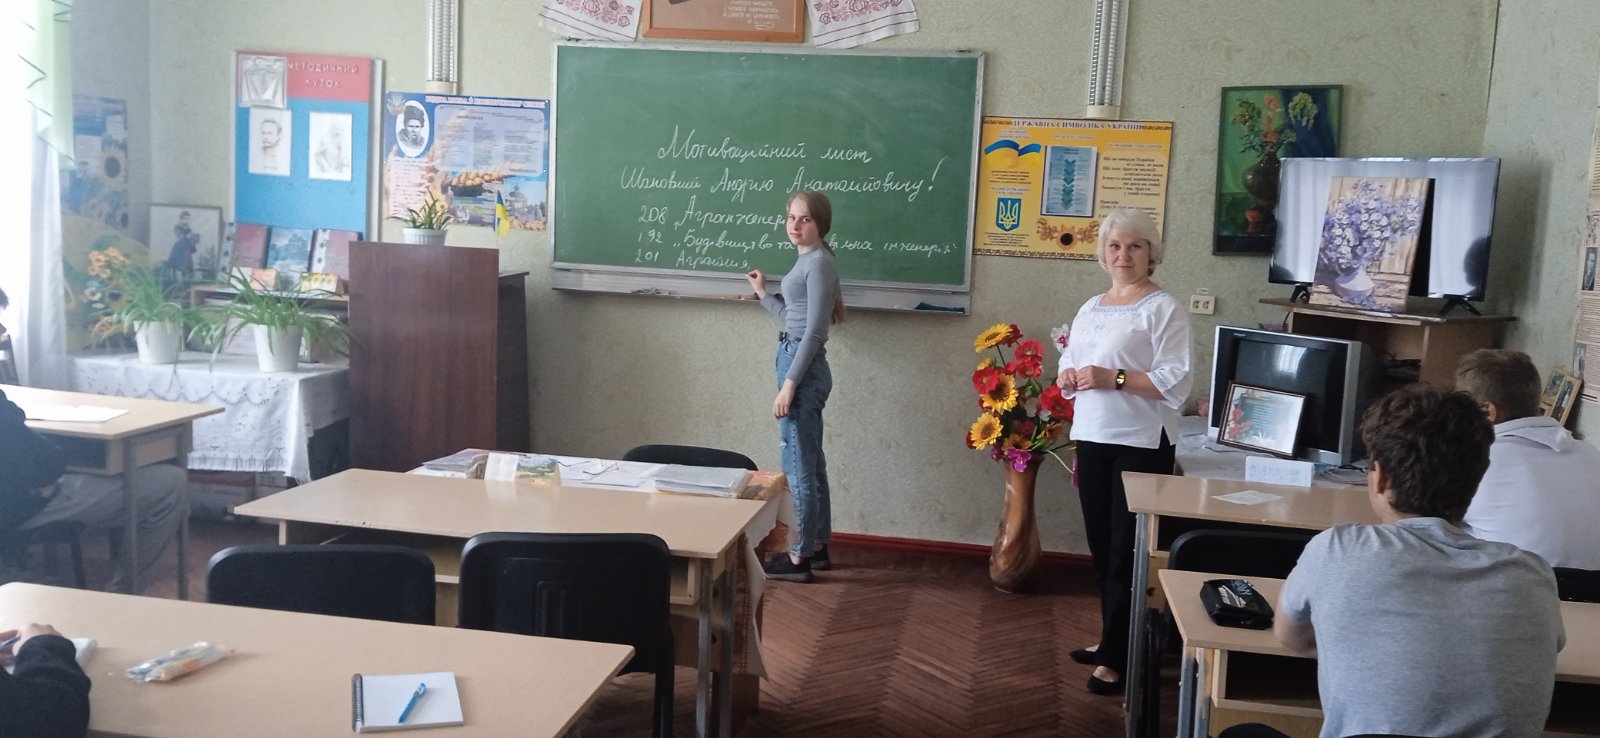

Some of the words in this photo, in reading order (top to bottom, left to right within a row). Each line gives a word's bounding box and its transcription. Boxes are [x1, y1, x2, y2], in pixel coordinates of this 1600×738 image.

[288, 61, 359, 74] МЕТОДИЧНИЙ
[305, 78, 342, 89] КУТОК
[658, 124, 807, 163] Мотиваційний
[820, 146, 873, 164] лист
[638, 205, 668, 225] 208
[828, 233, 872, 251] вільна
[635, 249, 659, 263] 201
